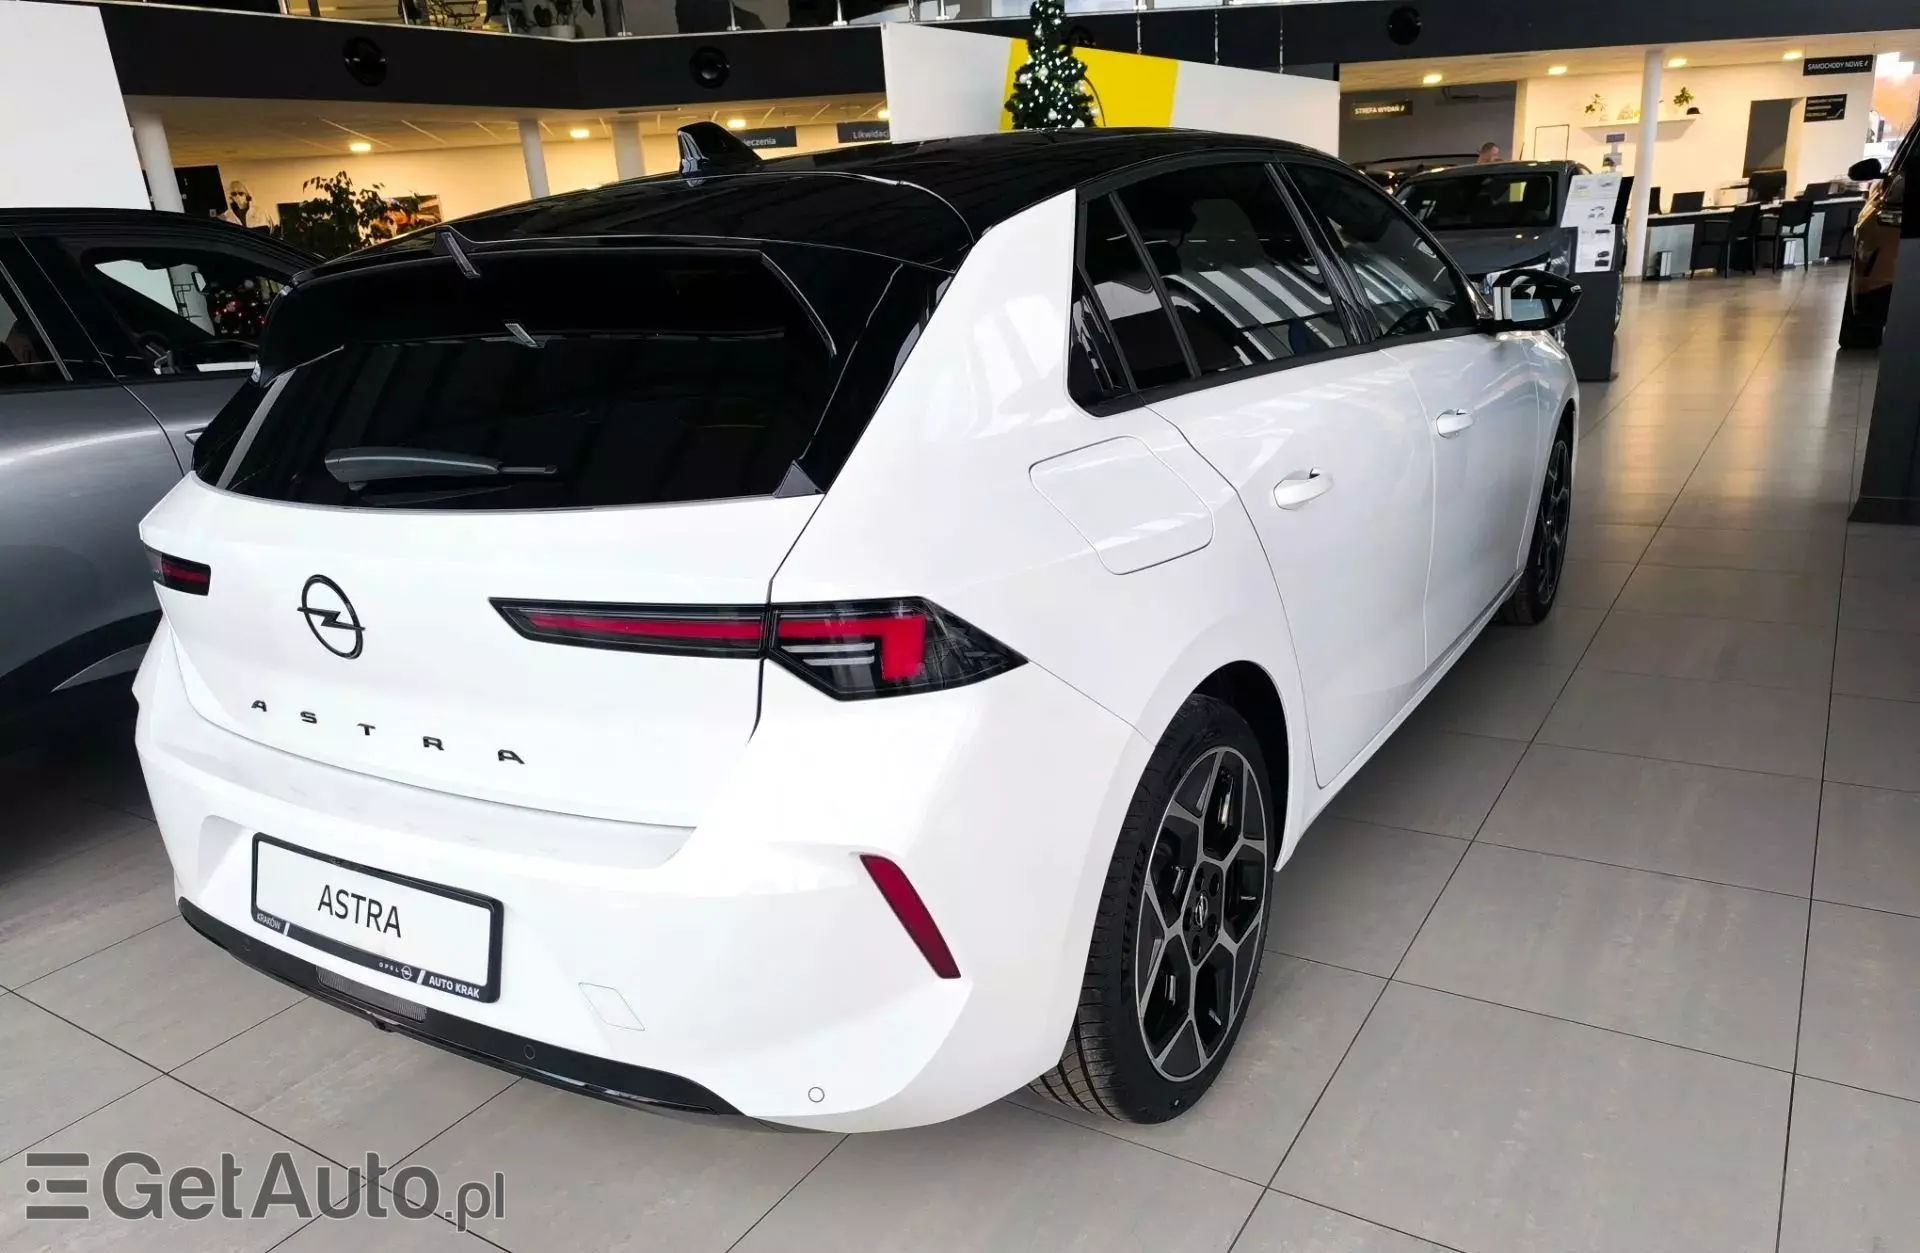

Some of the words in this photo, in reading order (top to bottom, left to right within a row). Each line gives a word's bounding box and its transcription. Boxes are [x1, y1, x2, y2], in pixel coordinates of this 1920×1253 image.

[251, 700, 525, 764] ASTRA
[317, 884, 402, 938] ASTRA
[378, 962, 399, 973] OPEL
[428, 975, 453, 990] AUTO
[455, 983, 480, 998] KRAK
